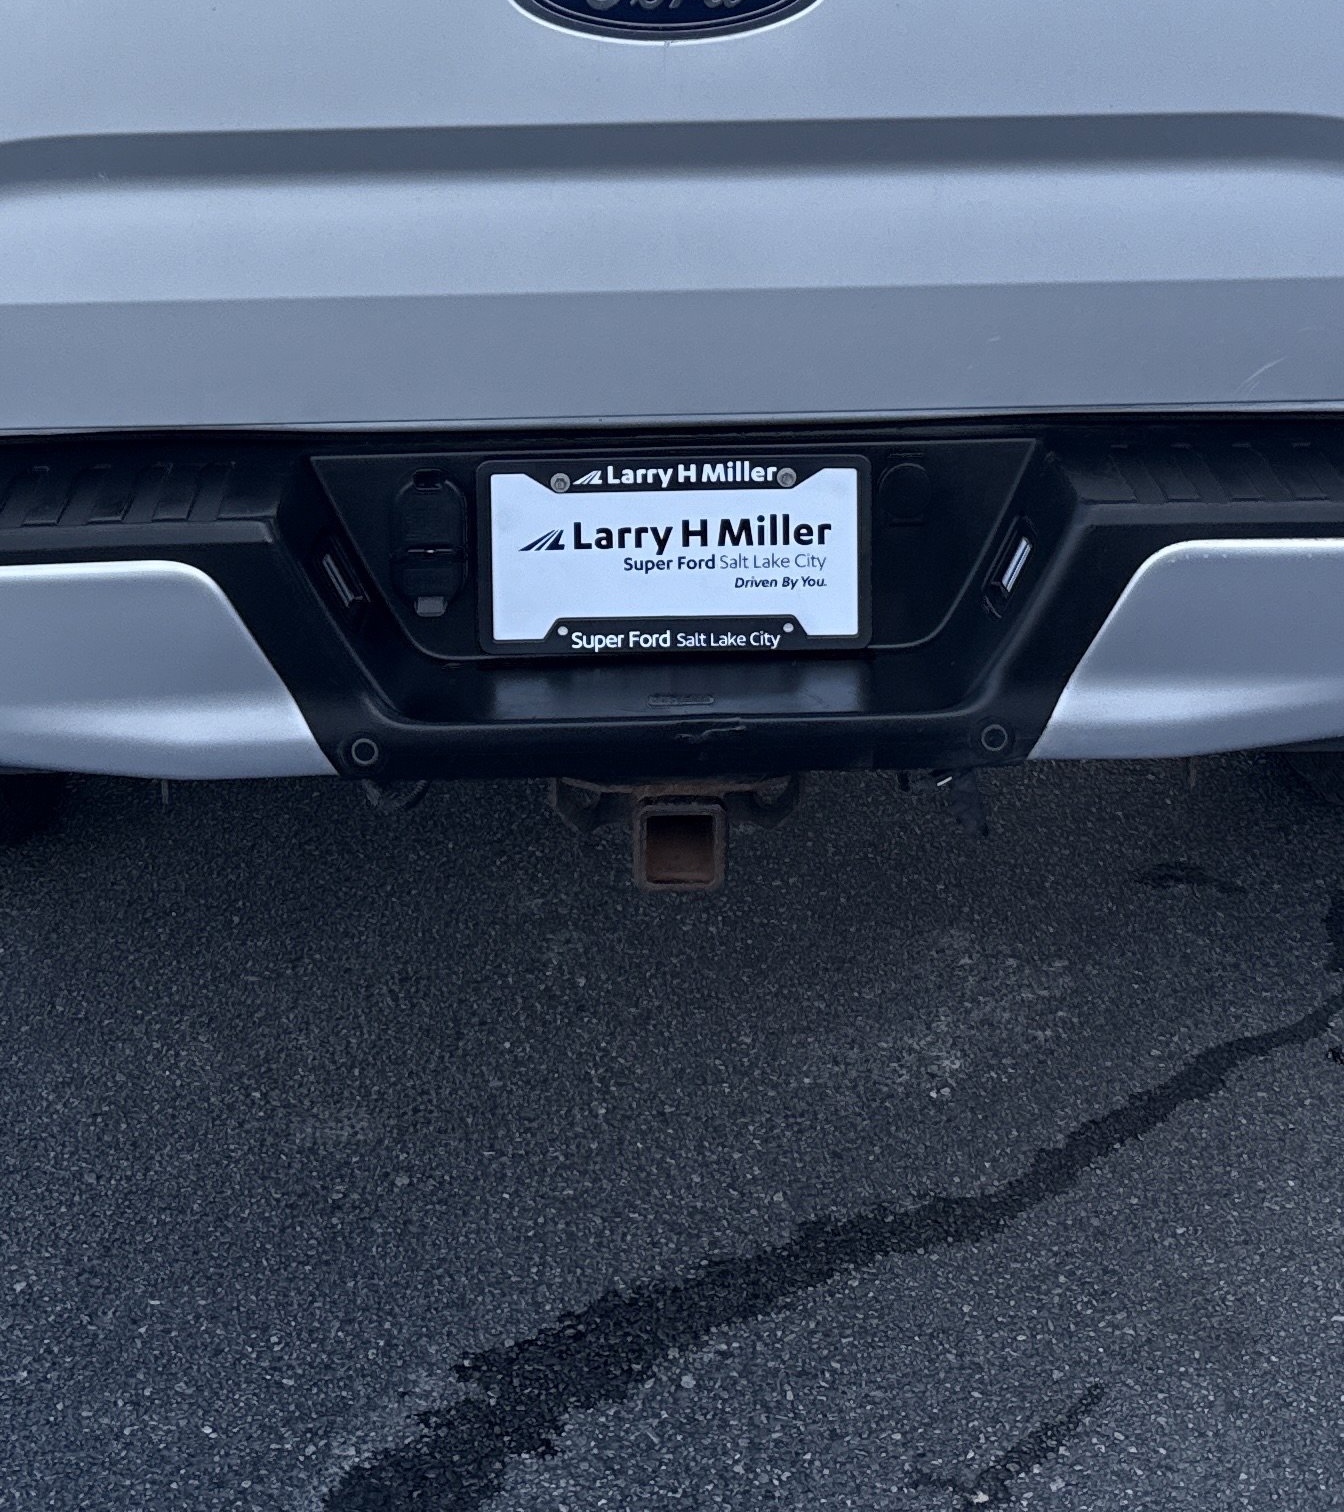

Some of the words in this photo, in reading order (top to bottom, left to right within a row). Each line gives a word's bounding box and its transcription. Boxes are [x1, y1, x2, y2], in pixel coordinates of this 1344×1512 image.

[607, 464, 673, 488] Larry
[678, 464, 696, 483] H
[701, 461, 777, 483] Miller
[573, 521, 673, 555] Larry
[681, 519, 708, 548] H
[718, 513, 831, 547] Miller
[623, 556, 674, 574] Super
[677, 554, 716, 570] Ford
[719, 553, 749, 569] Salt
[753, 553, 790, 569] Lake
[794, 553, 827, 571] City
[734, 576, 778, 589] Driven
[781, 576, 798, 590] By
[801, 575, 828, 588] You.
[571, 631, 625, 652] Super
[628, 630, 671, 648] Ford
[676, 631, 707, 647] Salt
[710, 630, 747, 647] Lake
[750, 629, 781, 649] City
